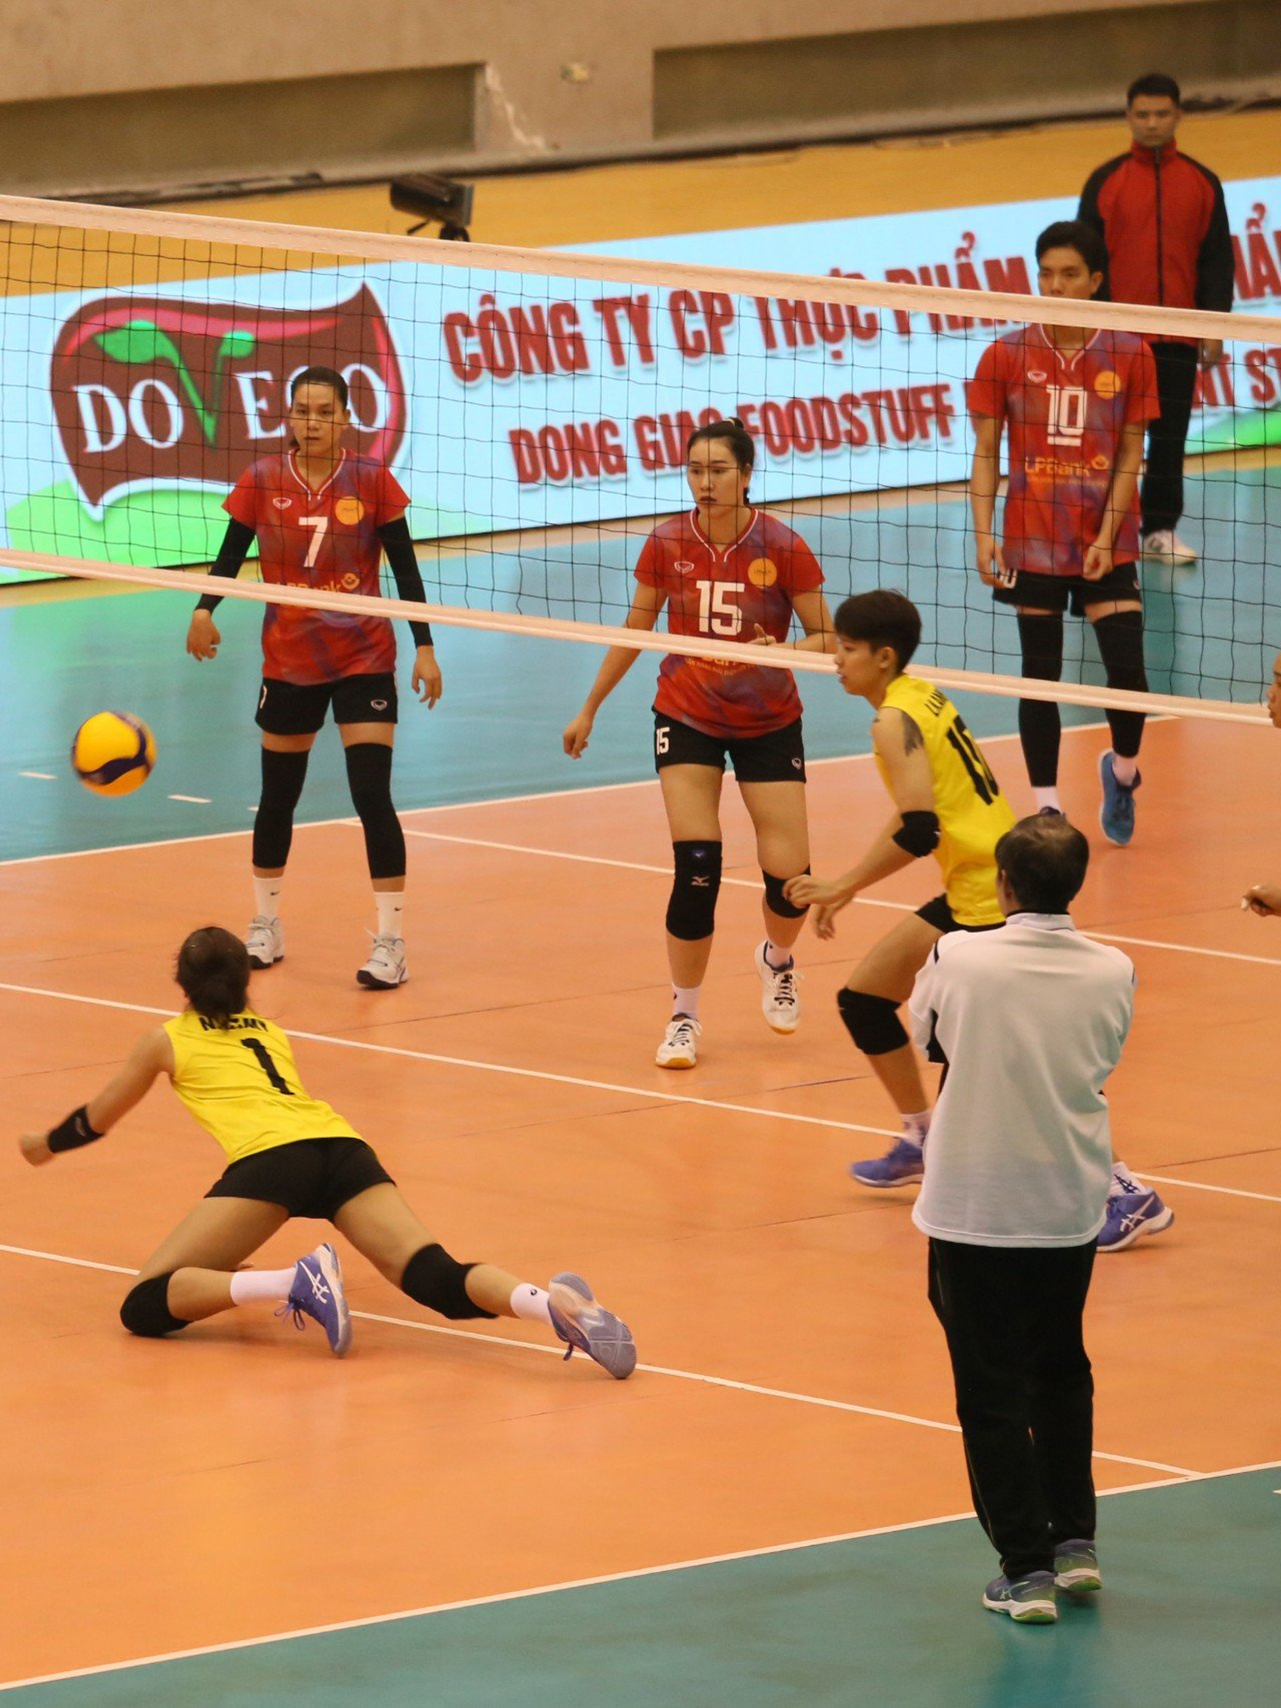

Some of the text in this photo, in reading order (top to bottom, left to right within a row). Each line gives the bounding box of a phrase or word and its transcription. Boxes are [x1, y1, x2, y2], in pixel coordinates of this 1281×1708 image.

[442, 293, 589, 383] CÔNG
[592, 294, 654, 366] TY
[669, 290, 734, 359] CP
[73, 320, 390, 453] DOVEO
[1046, 384, 1088, 437] 10
[509, 420, 627, 483] DONG
[737, 384, 954, 457] FOODSTUFF
[298, 516, 328, 568] 7
[696, 580, 745, 636] 15
[656, 727, 670, 755] 15
[239, 1037, 296, 1096] 1
